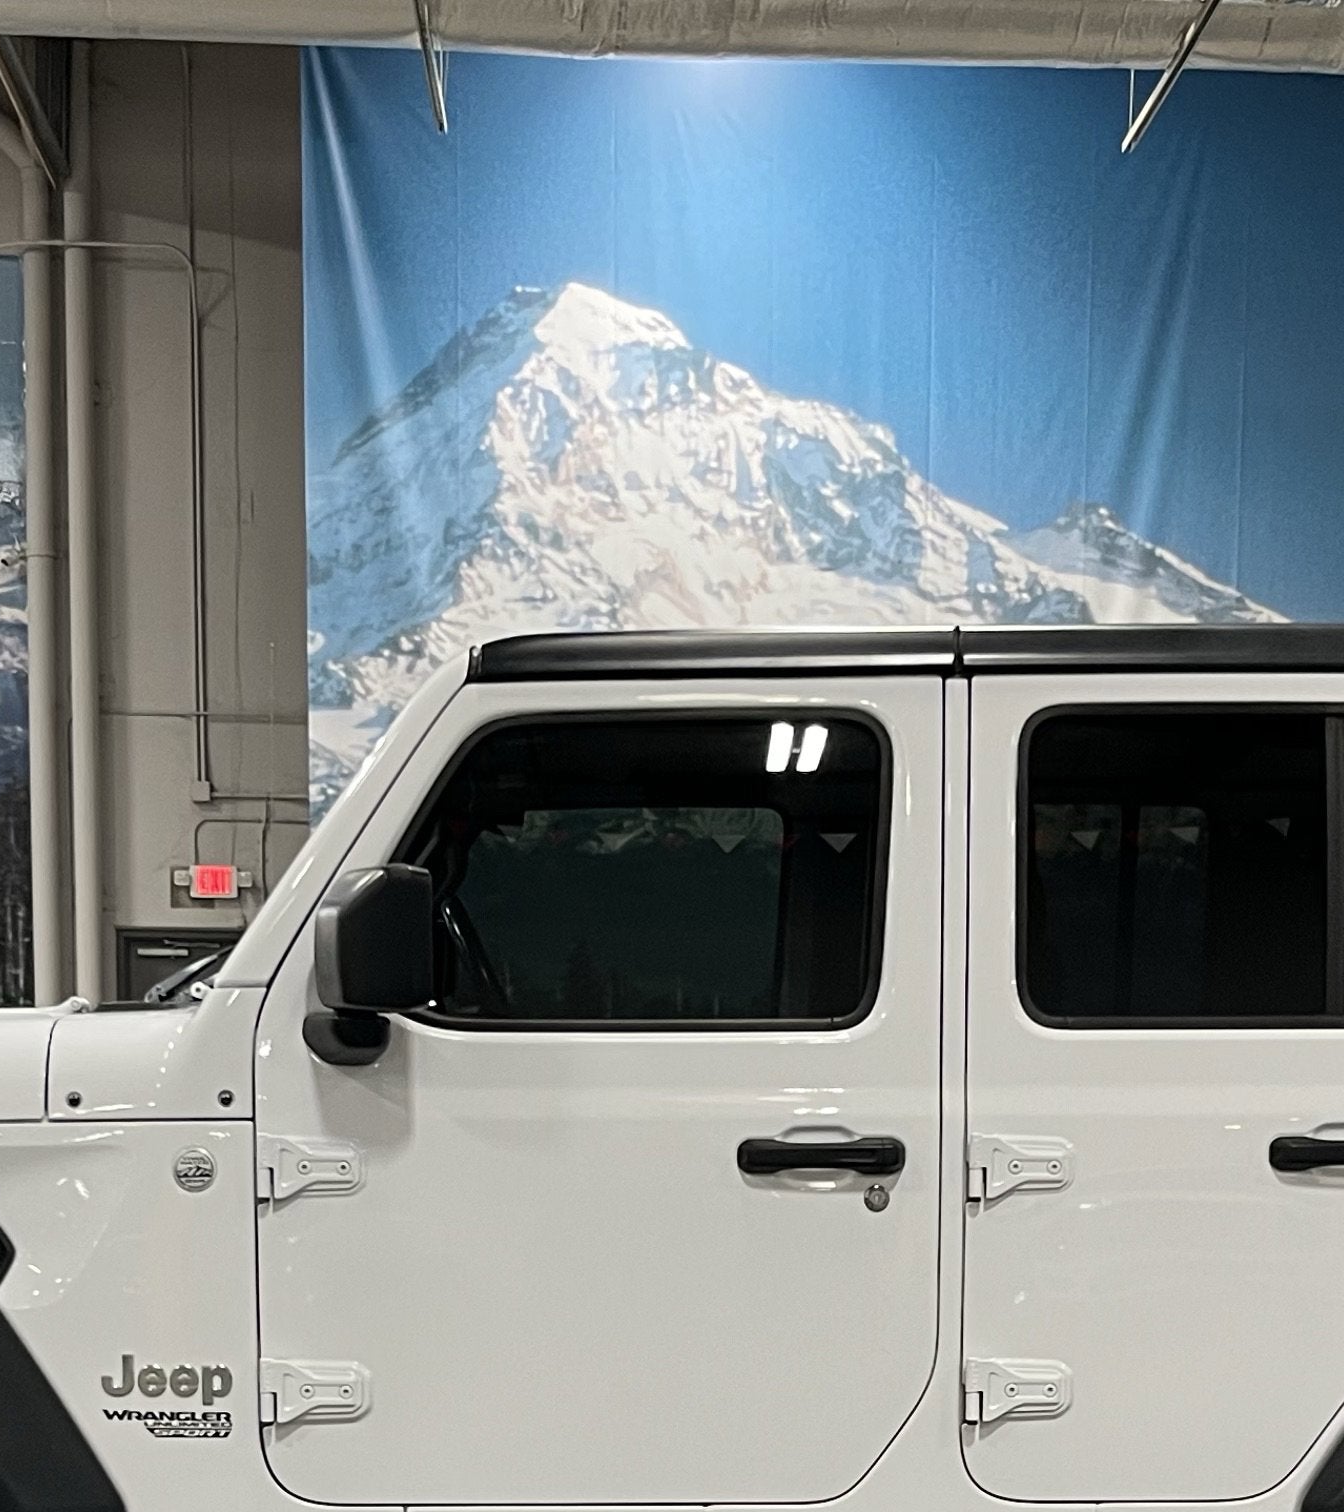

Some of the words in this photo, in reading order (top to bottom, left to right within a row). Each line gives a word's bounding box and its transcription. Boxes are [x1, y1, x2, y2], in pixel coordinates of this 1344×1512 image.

[199, 869, 232, 894] EXIT
[101, 1354, 233, 1406] Jeep
[102, 1409, 232, 1421] WRANGLER
[153, 1429, 230, 1437] SPORT
